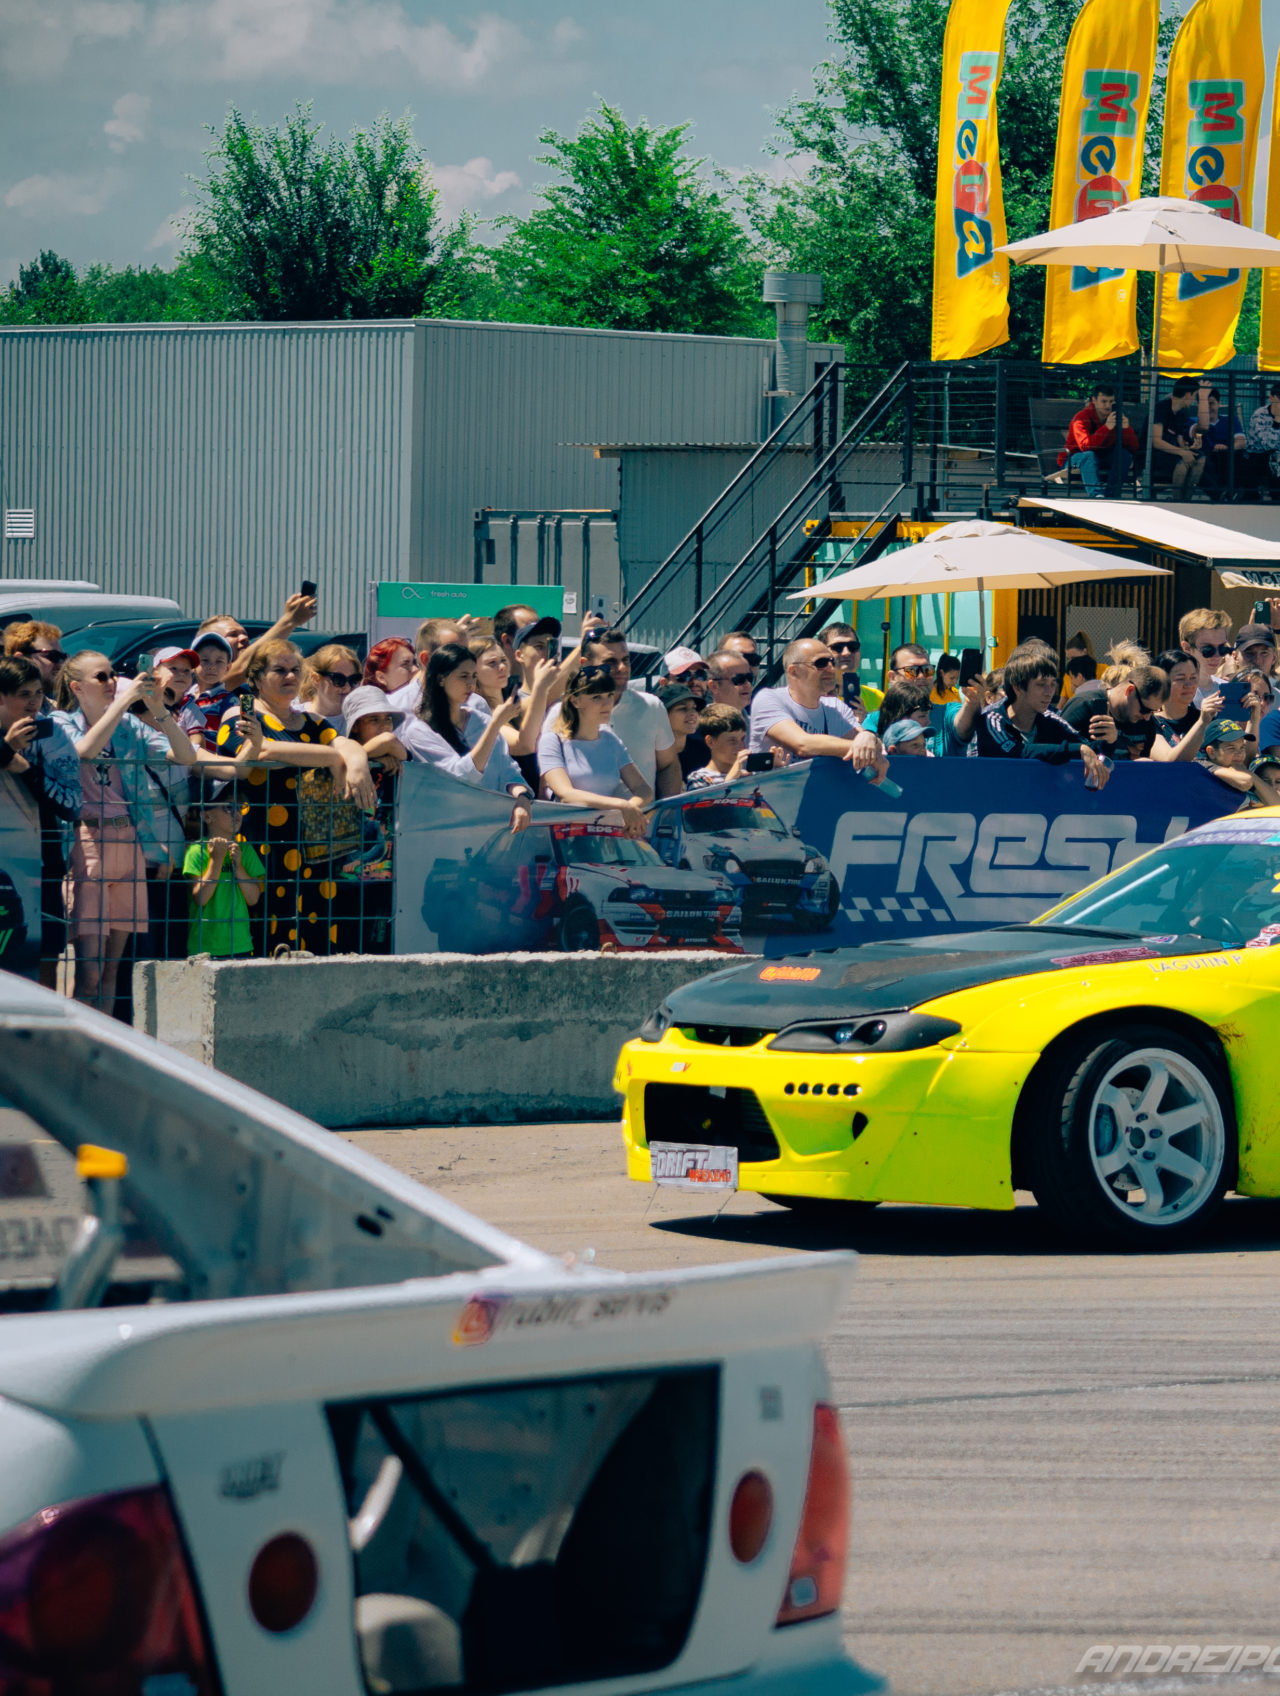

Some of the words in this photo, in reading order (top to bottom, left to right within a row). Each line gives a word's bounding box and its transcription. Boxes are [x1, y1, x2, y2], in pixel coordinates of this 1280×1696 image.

[430, 590, 450, 598] fresh
[1149, 956, 1229, 973] LAGUTIN
[655, 1149, 710, 1178] DRIFT
